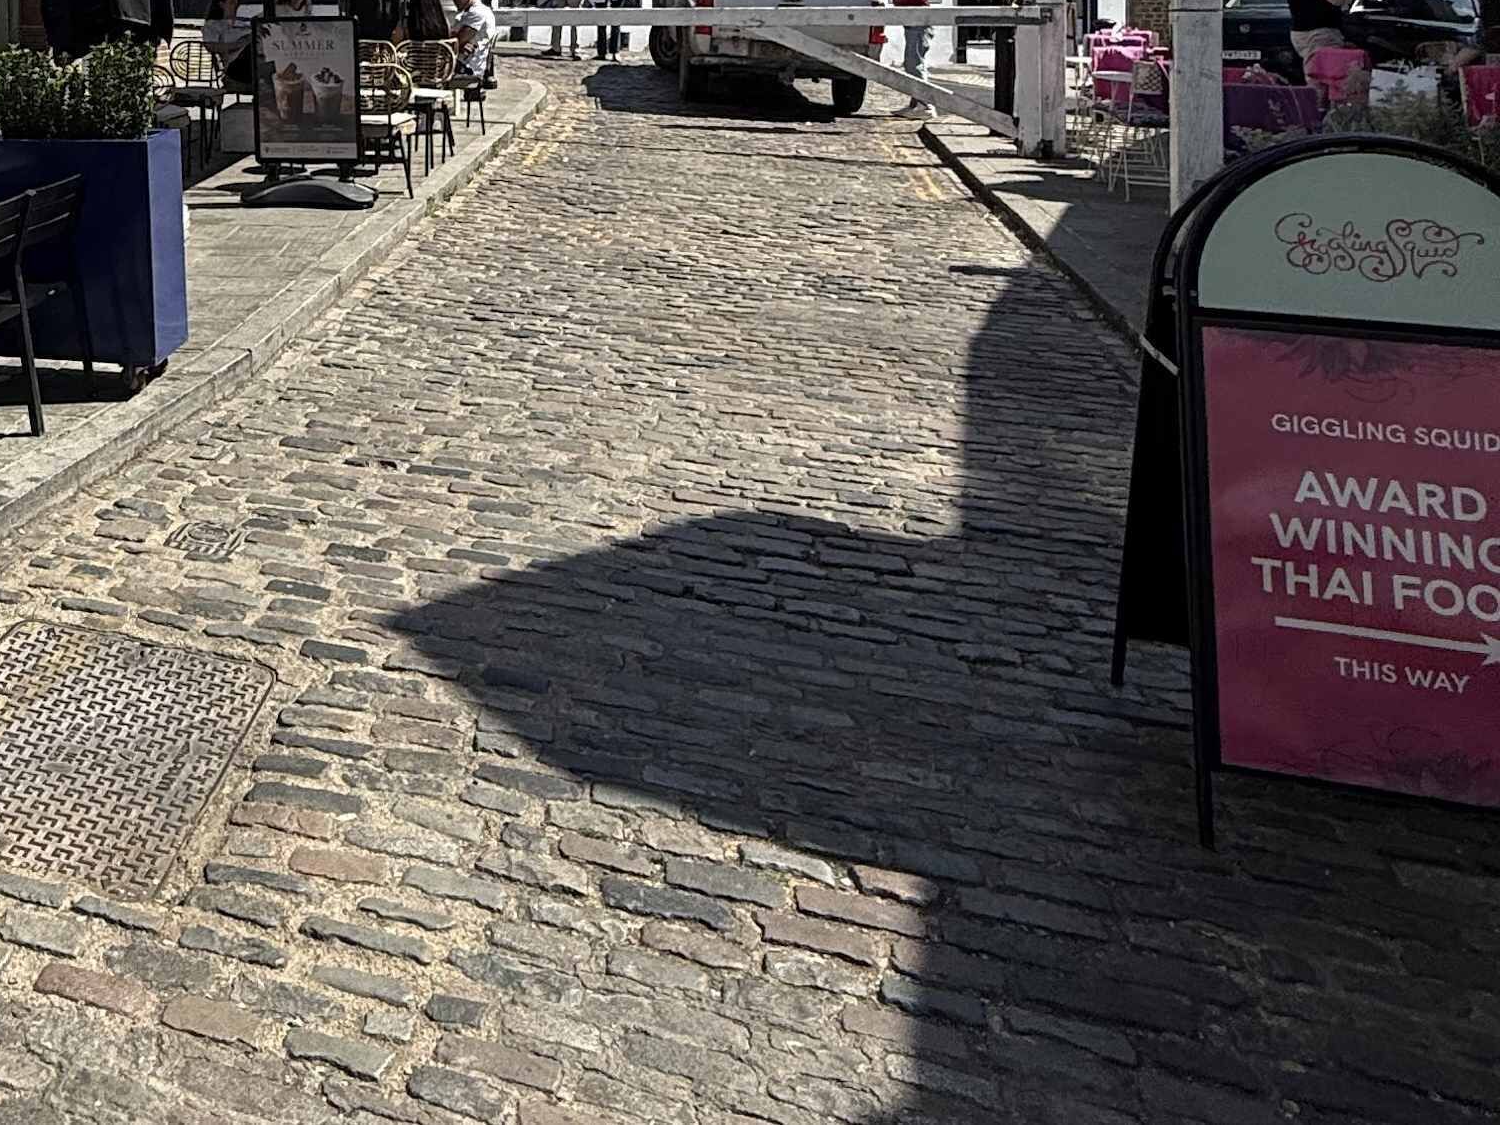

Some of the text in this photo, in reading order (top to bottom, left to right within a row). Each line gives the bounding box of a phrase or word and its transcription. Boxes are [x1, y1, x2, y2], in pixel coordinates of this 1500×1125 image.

[1274, 212, 1485, 282] Giggling Squid
[1270, 413, 1500, 452] GIGGLING SQUID
[1293, 469, 1487, 523] AWARD
[1250, 555, 1374, 607] THAI
[1333, 656, 1470, 695] THIS WAY
